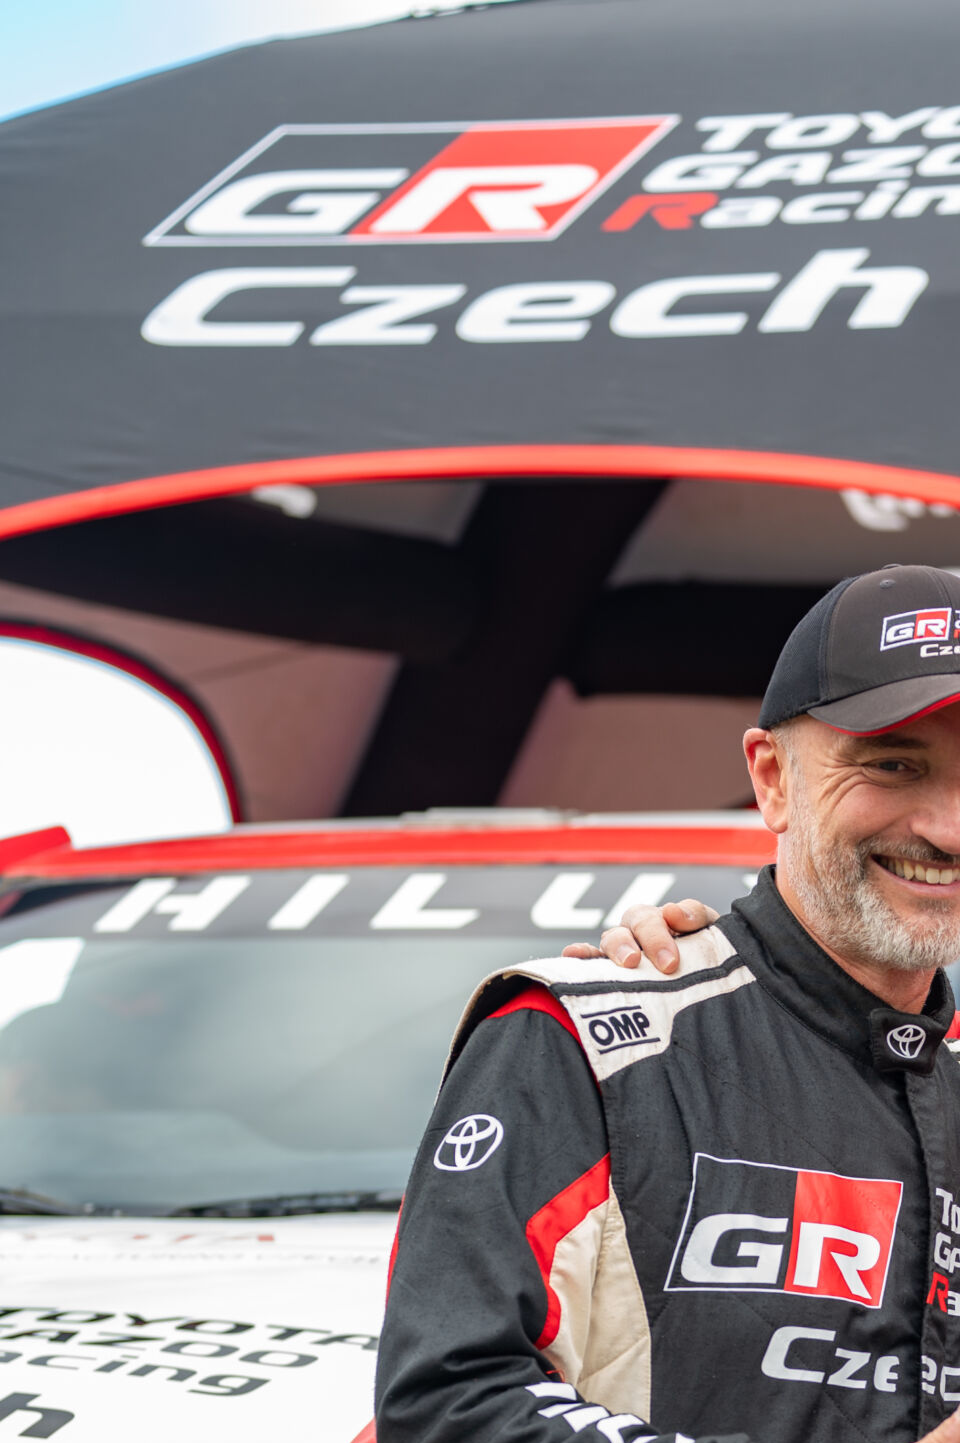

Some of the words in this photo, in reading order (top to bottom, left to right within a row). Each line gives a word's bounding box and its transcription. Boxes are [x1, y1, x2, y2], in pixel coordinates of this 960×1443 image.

[184, 166, 601, 236] GR
[140, 247, 930, 347] Czech
[885, 618, 947, 644] GR
[93, 872, 760, 933] HILU
[588, 1011, 651, 1047] OMP
[680, 1212, 882, 1300] GR
[0, 1324, 319, 1369] AZOO
